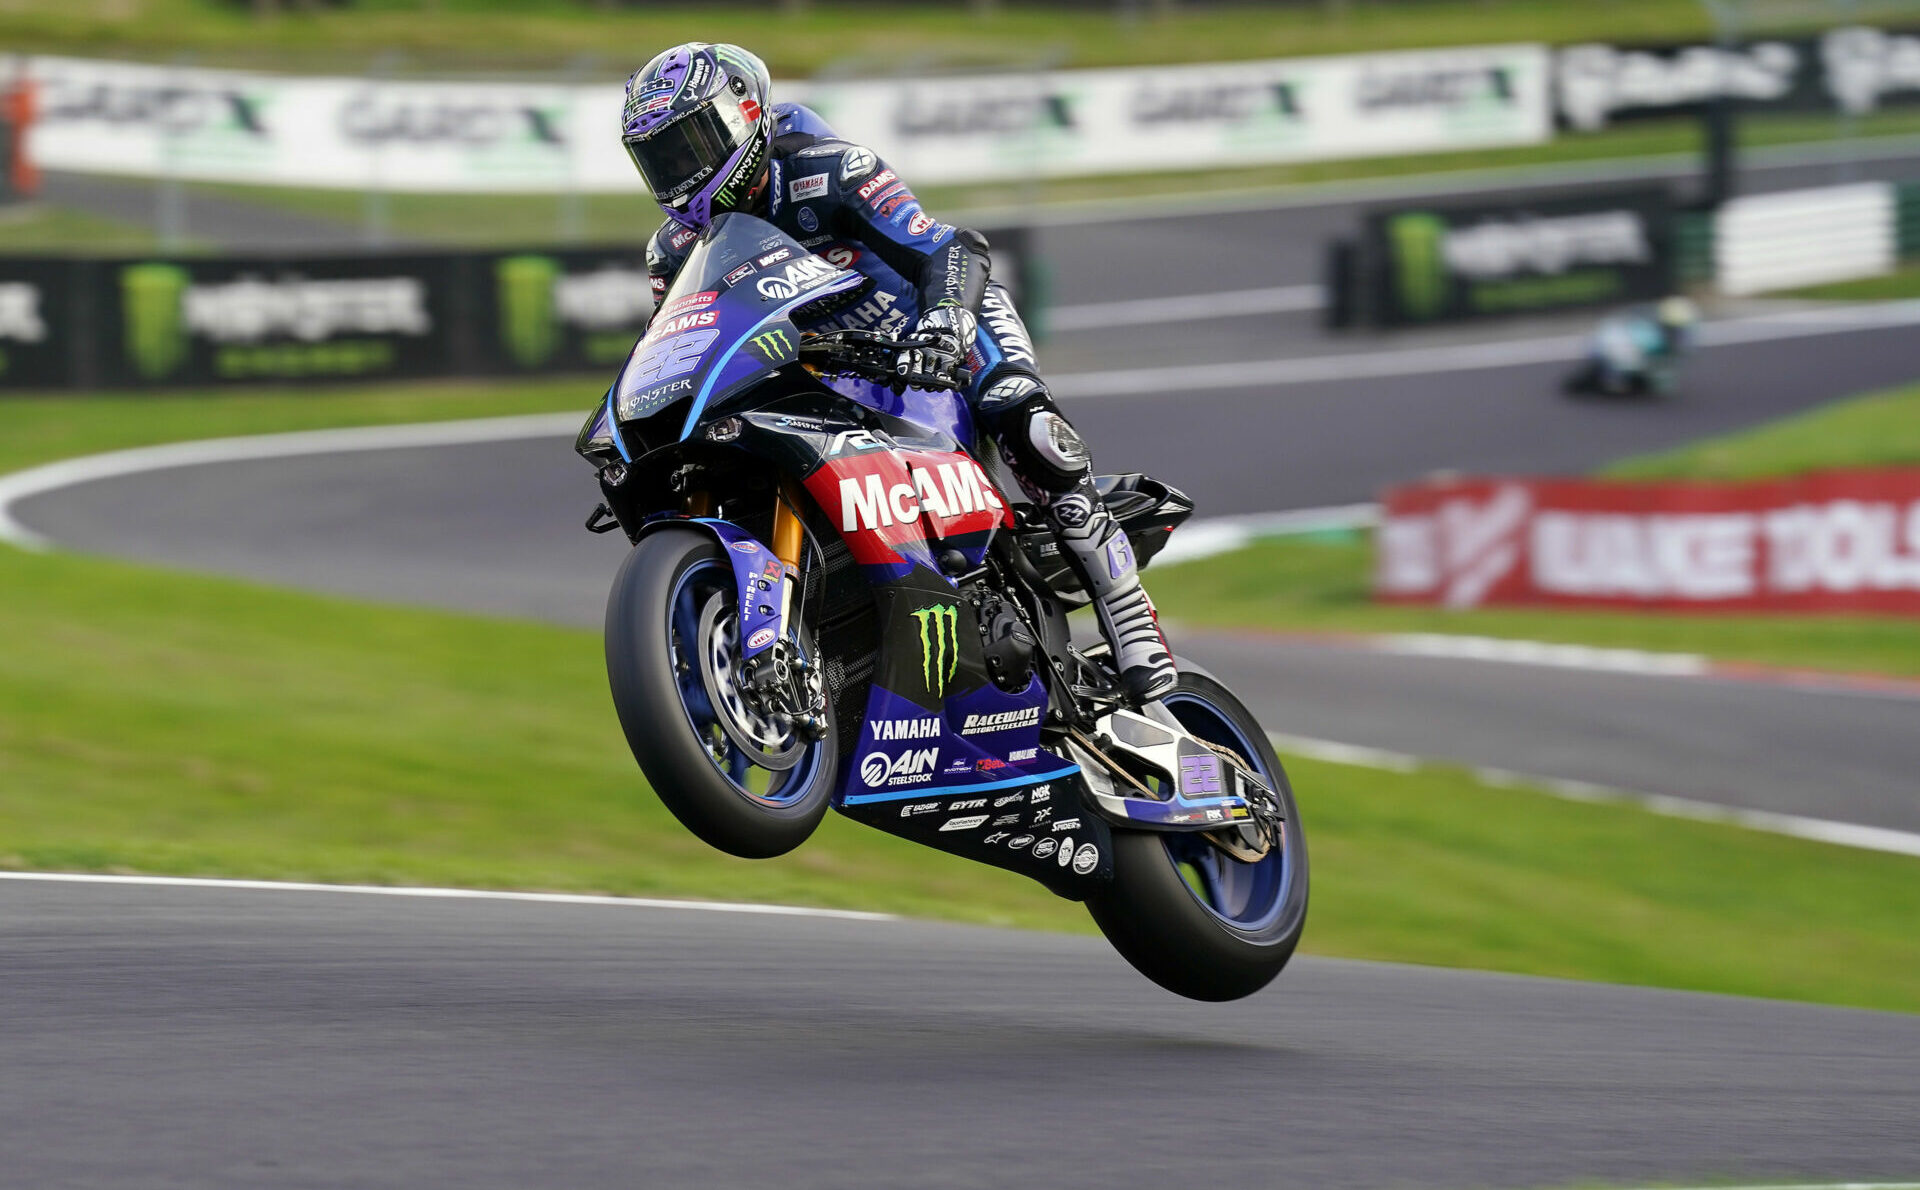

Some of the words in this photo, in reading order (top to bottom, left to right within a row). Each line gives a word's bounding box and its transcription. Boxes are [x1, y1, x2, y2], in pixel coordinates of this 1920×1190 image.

[728, 139, 763, 189] MONSTER
[800, 176, 824, 191] YAMAHA
[859, 169, 896, 199] DAMS
[672, 231, 698, 248] Mc
[945, 245, 962, 296] MONSTER
[620, 329, 720, 397] 22
[619, 379, 693, 413] MONSTER
[839, 460, 1003, 532] McAMS
[744, 572, 758, 621] PIRELLI
[870, 717, 941, 740] YAMAHA
[962, 719, 1039, 735] MOTORCYCLES.CO.UK
[964, 707, 1040, 728] RACEWAYS
[888, 773, 932, 786] STEELSTOCK
[1180, 755, 1222, 796] 22
[1031, 784, 1051, 800] NGK
[948, 798, 988, 811] GYTR
[1206, 809, 1223, 819] RK
